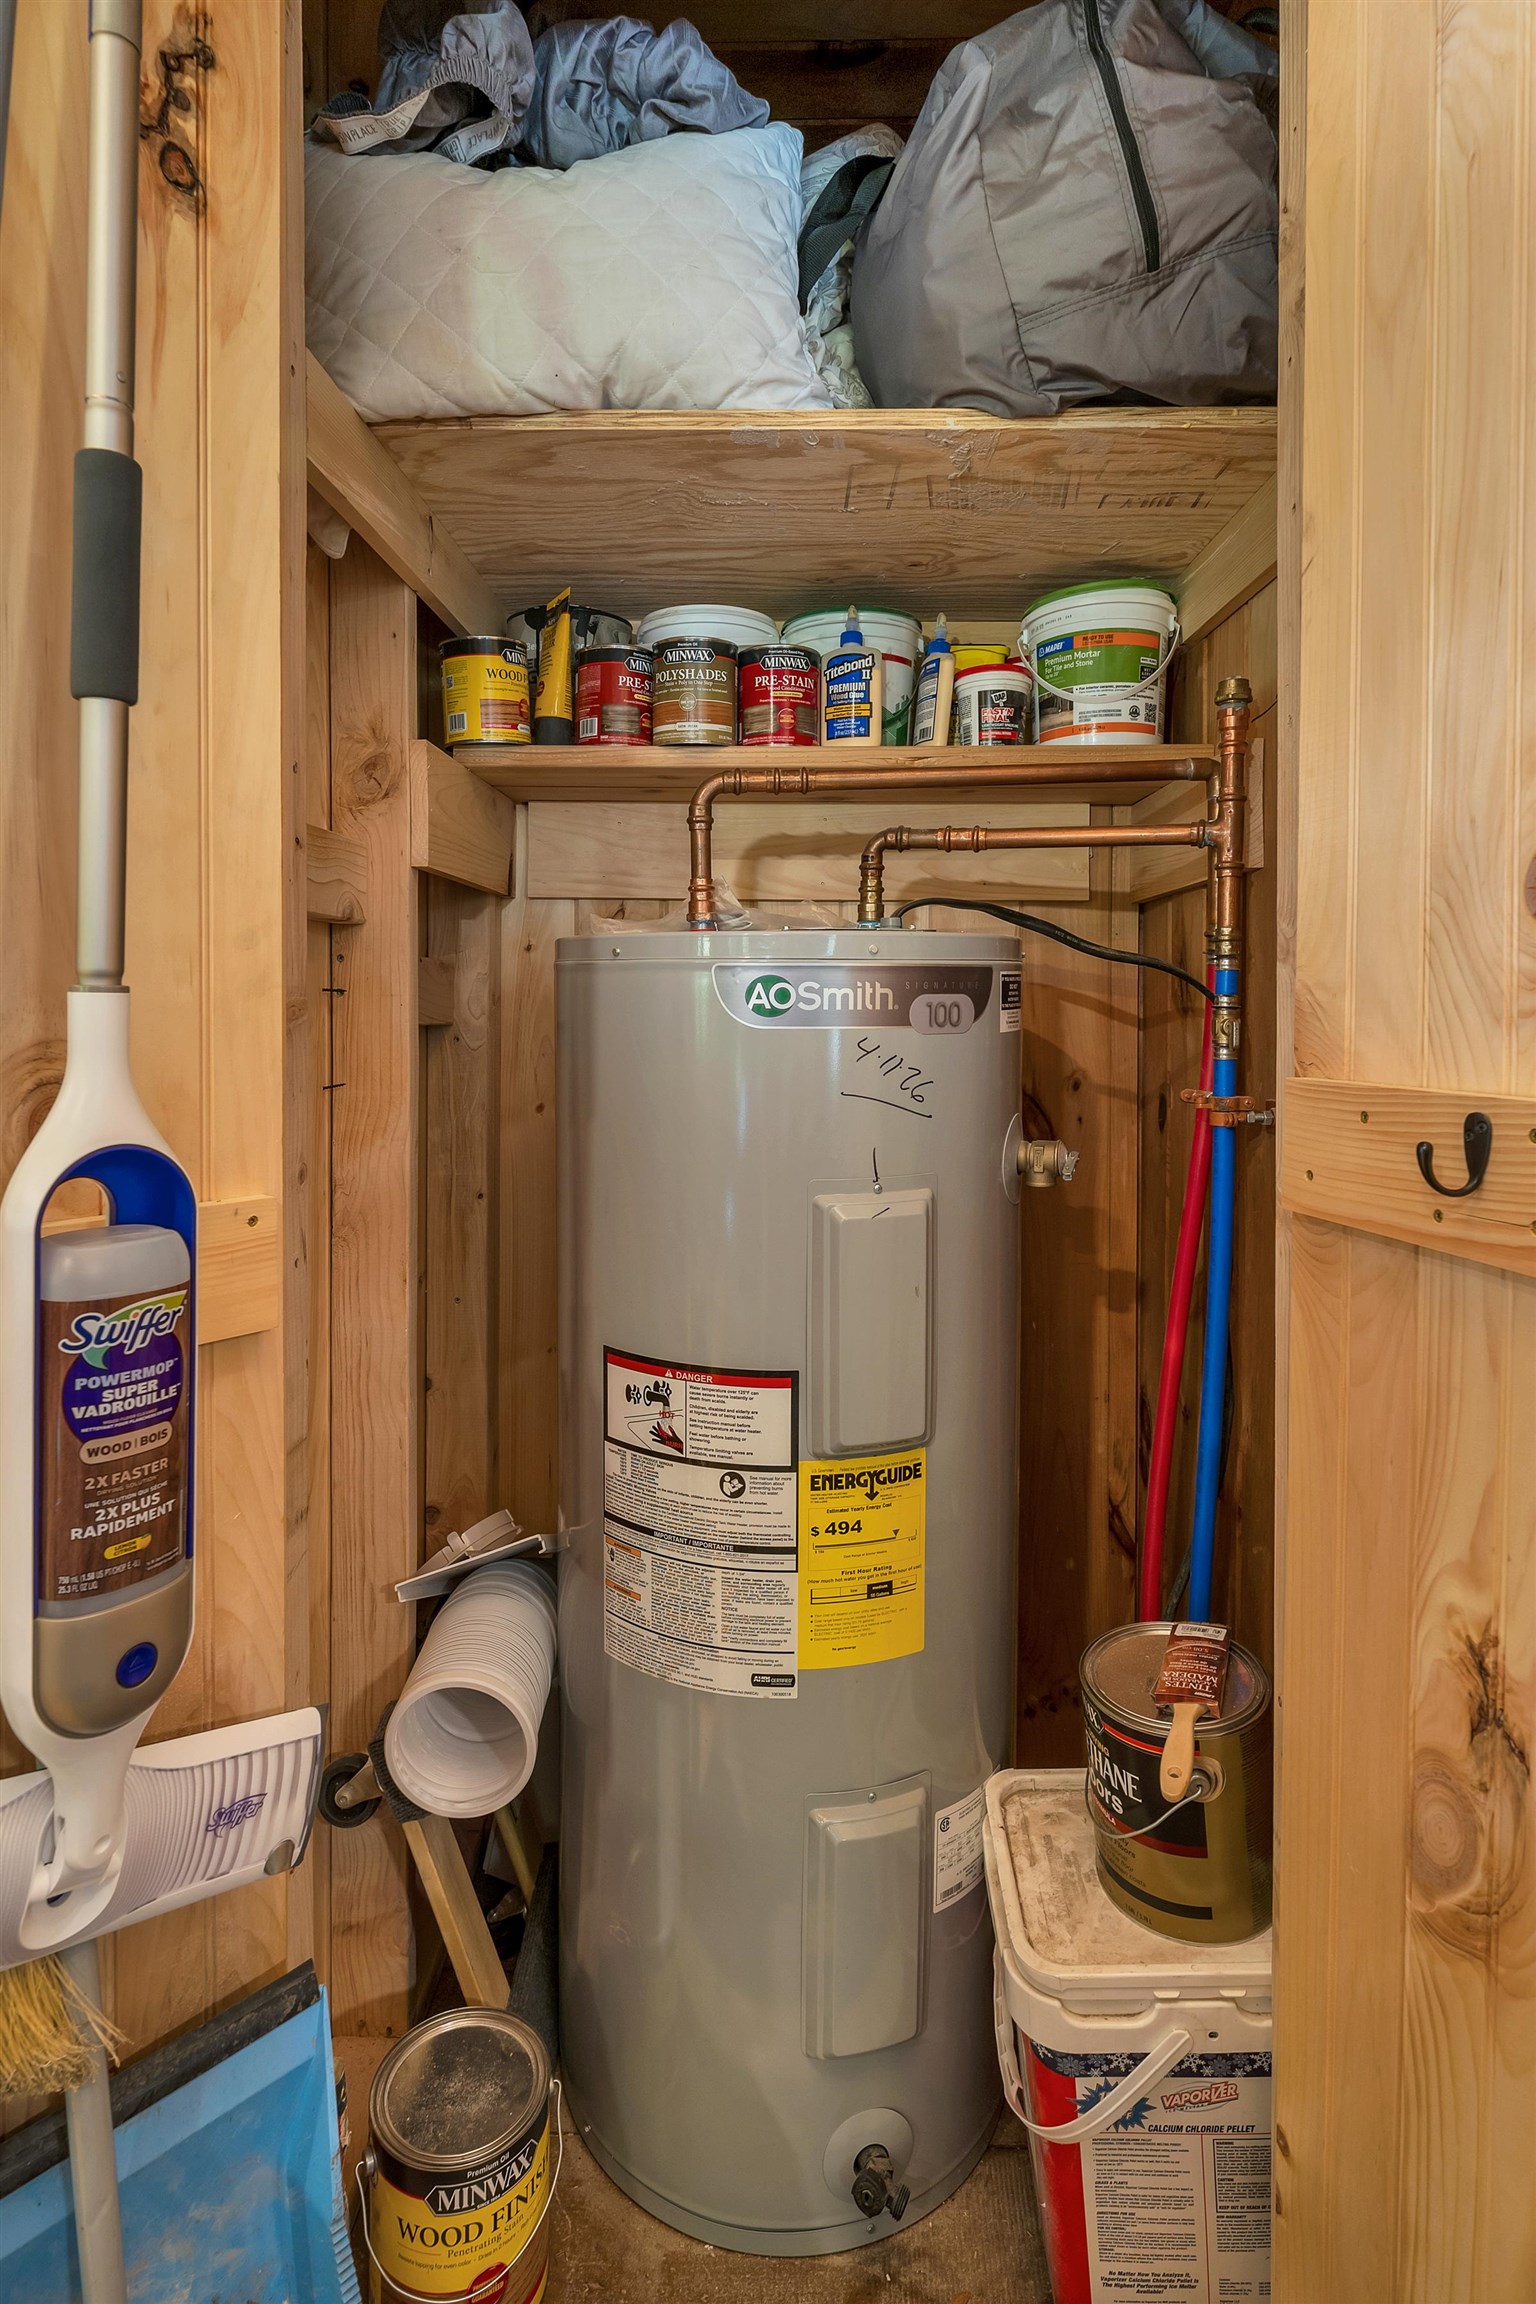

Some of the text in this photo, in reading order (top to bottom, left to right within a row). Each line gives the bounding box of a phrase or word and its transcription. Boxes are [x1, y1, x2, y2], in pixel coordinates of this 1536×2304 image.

[666, 649, 712, 662] MINWAX
[1044, 641, 1064, 653] MAPEI
[764, 656, 808, 670] MINWAX
[1045, 650, 1101, 667] Premium Mortar
[486, 668, 523, 682] WOOD
[655, 668, 728, 684] POLYSHADES
[824, 655, 873, 681] Titebond
[861, 669, 871, 680] II
[754, 674, 815, 689] PRE-STAIN
[829, 682, 866, 694] PREMIUM
[994, 692, 1006, 701] DAP
[981, 714, 1010, 723] FINAL
[905, 980, 979, 989] SIGNATURE
[926, 1001, 961, 1028] 100
[60, 1304, 184, 1354] Swiffer
[676, 1371, 713, 1383] DANGER
[102, 1379, 159, 1402] SUPER
[71, 1386, 178, 1419] VADROUILLE
[86, 1428, 168, 1457] WOOD BOIS
[84, 1458, 168, 1490] 2X FASTER
[810, 1462, 922, 1493] ENERGYGUIDE
[97, 1485, 124, 1496] DRYING
[102, 1493, 137, 1506] SOLUTION
[138, 1488, 149, 1496] QUI
[95, 1493, 160, 1522] 2X PLUS
[70, 1499, 176, 1540] RAPIDEMENT
[810, 1519, 863, 1537] $ 494
[114, 1540, 137, 1551] LEMON
[653, 1531, 734, 1551] IMPORTANT IMPORTANTE
[113, 1546, 137, 1556] CITRON
[1163, 1671, 1218, 1683] MADERA
[1165, 1681, 1213, 1693] TINTES
[207, 1801, 263, 1832] Swiffer
[1160, 2081, 1239, 2110] VAPORIZER
[1148, 2124, 1256, 2133] CALCIUM CHLORIDE PELLET
[466, 2152, 510, 2179] Premium Oil
[437, 2147, 532, 2212] MINWAX
[396, 2216, 484, 2248] WOOD
[447, 2213, 524, 2258] Penetrating Stain
